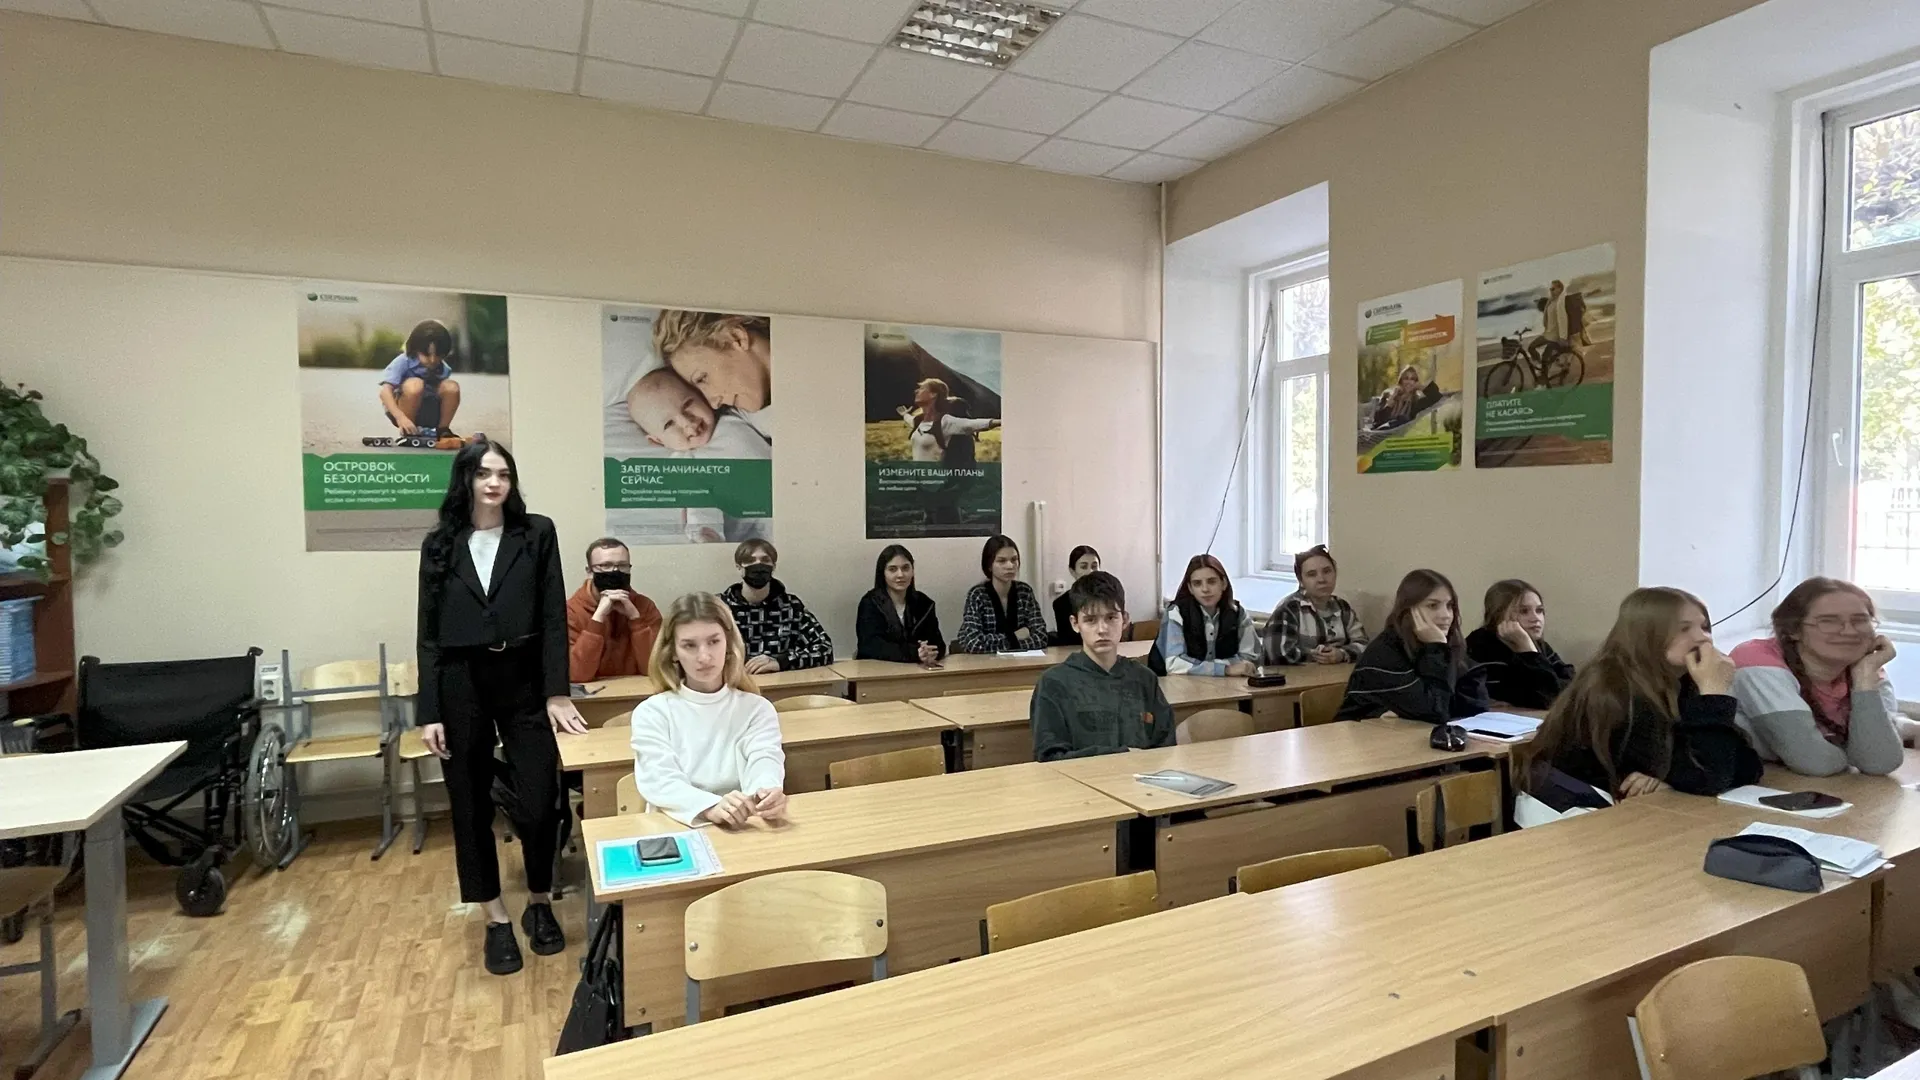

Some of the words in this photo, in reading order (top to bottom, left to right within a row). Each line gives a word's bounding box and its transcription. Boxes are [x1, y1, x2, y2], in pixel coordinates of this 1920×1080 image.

[323, 461, 396, 472] ОСТРОВОК
[620, 464, 661, 474] ЗАВТРА
[662, 465, 730, 474] НАЧИНАЕТСЯ
[878, 468, 926, 477] ИЗМЕНИТЕ
[927, 468, 953, 477] ВАШИ
[954, 469, 985, 477] ПЛАНЫ
[323, 473, 430, 484] БЕЗОПАСНОСТИ
[620, 475, 664, 485] СЕЙЧАС
